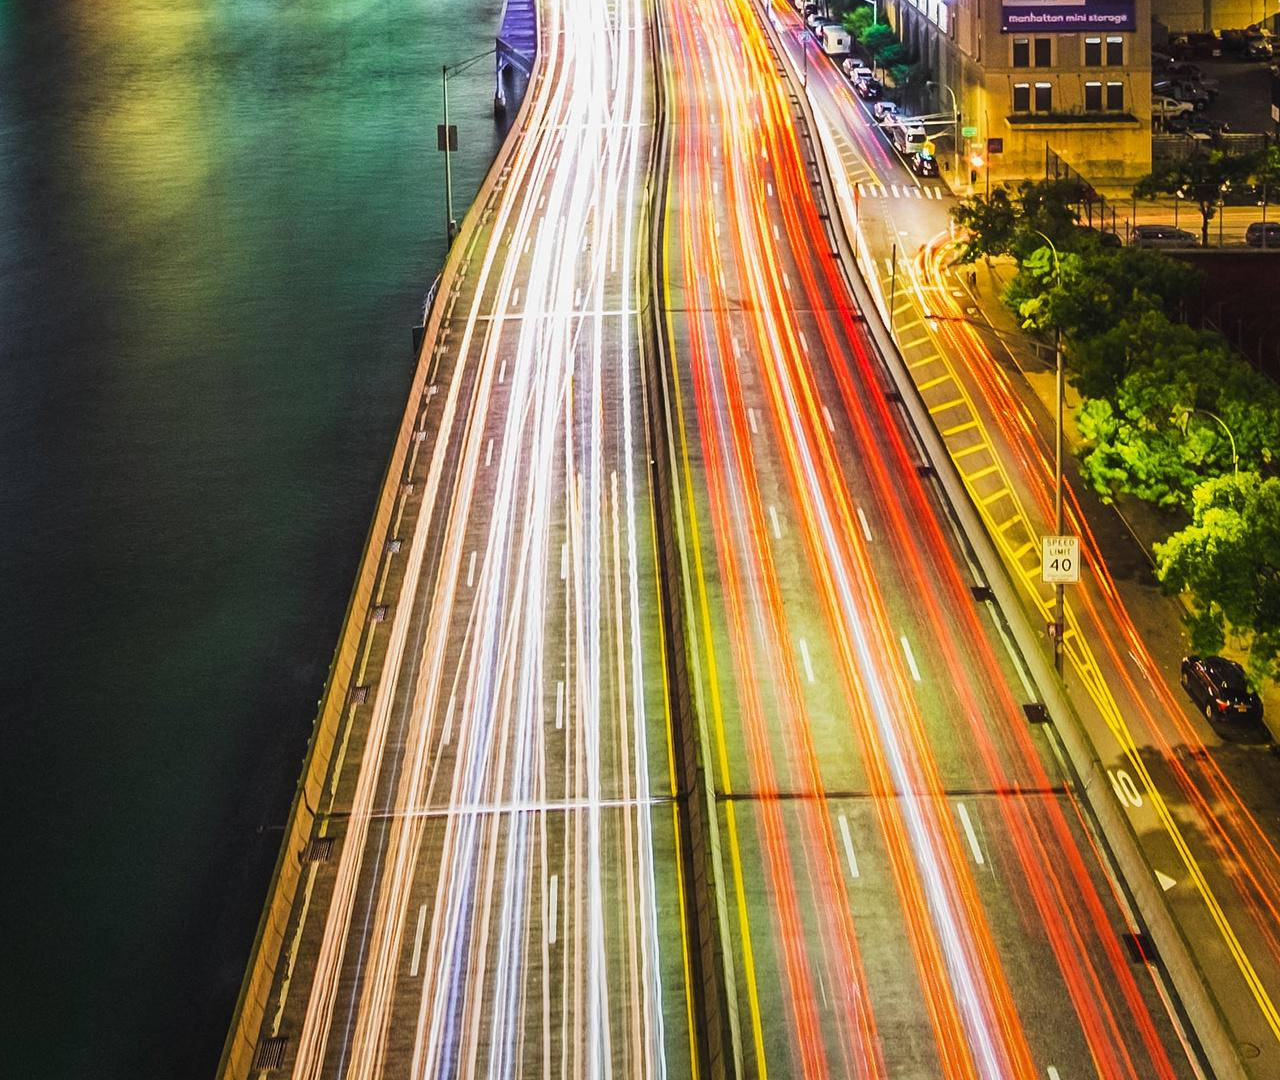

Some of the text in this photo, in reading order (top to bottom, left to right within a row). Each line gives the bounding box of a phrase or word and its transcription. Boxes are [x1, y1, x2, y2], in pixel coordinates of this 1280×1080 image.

[1008, 13, 1127, 24] manhattan mini storage
[1046, 539, 1075, 547] SPEED
[1049, 548, 1071, 556] LIMIT
[1049, 558, 1072, 572] 40
